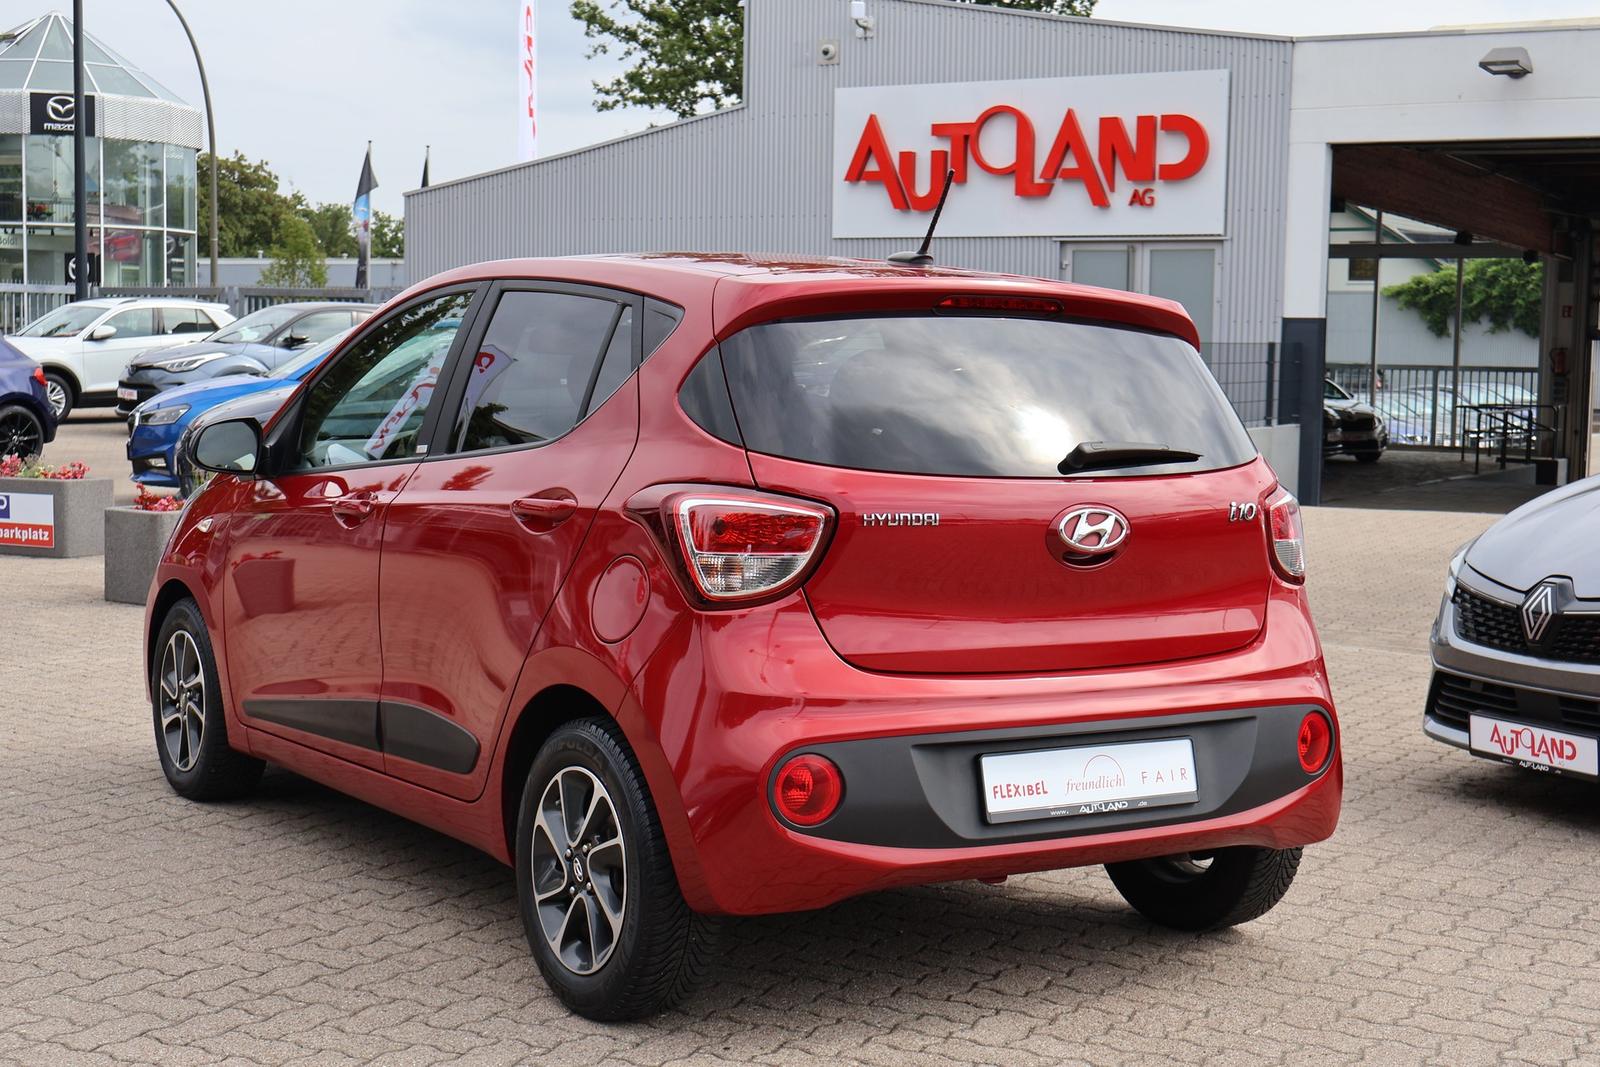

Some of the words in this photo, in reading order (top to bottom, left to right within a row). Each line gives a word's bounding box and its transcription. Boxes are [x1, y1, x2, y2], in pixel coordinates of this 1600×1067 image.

[43, 122, 75, 131] mazd
[844, 104, 1210, 212] AUTOLAND
[1127, 188, 1155, 206] AG
[863, 513, 940, 527] HYUNDAI
[1230, 501, 1257, 522] i10
[1490, 723, 1577, 763] AUTOLAND
[992, 780, 1048, 800] FLEXIBEL
[1065, 774, 1122, 796] freundlich
[1141, 767, 1188, 785] FAIR
[1079, 801, 1129, 814] AUTOLAND
